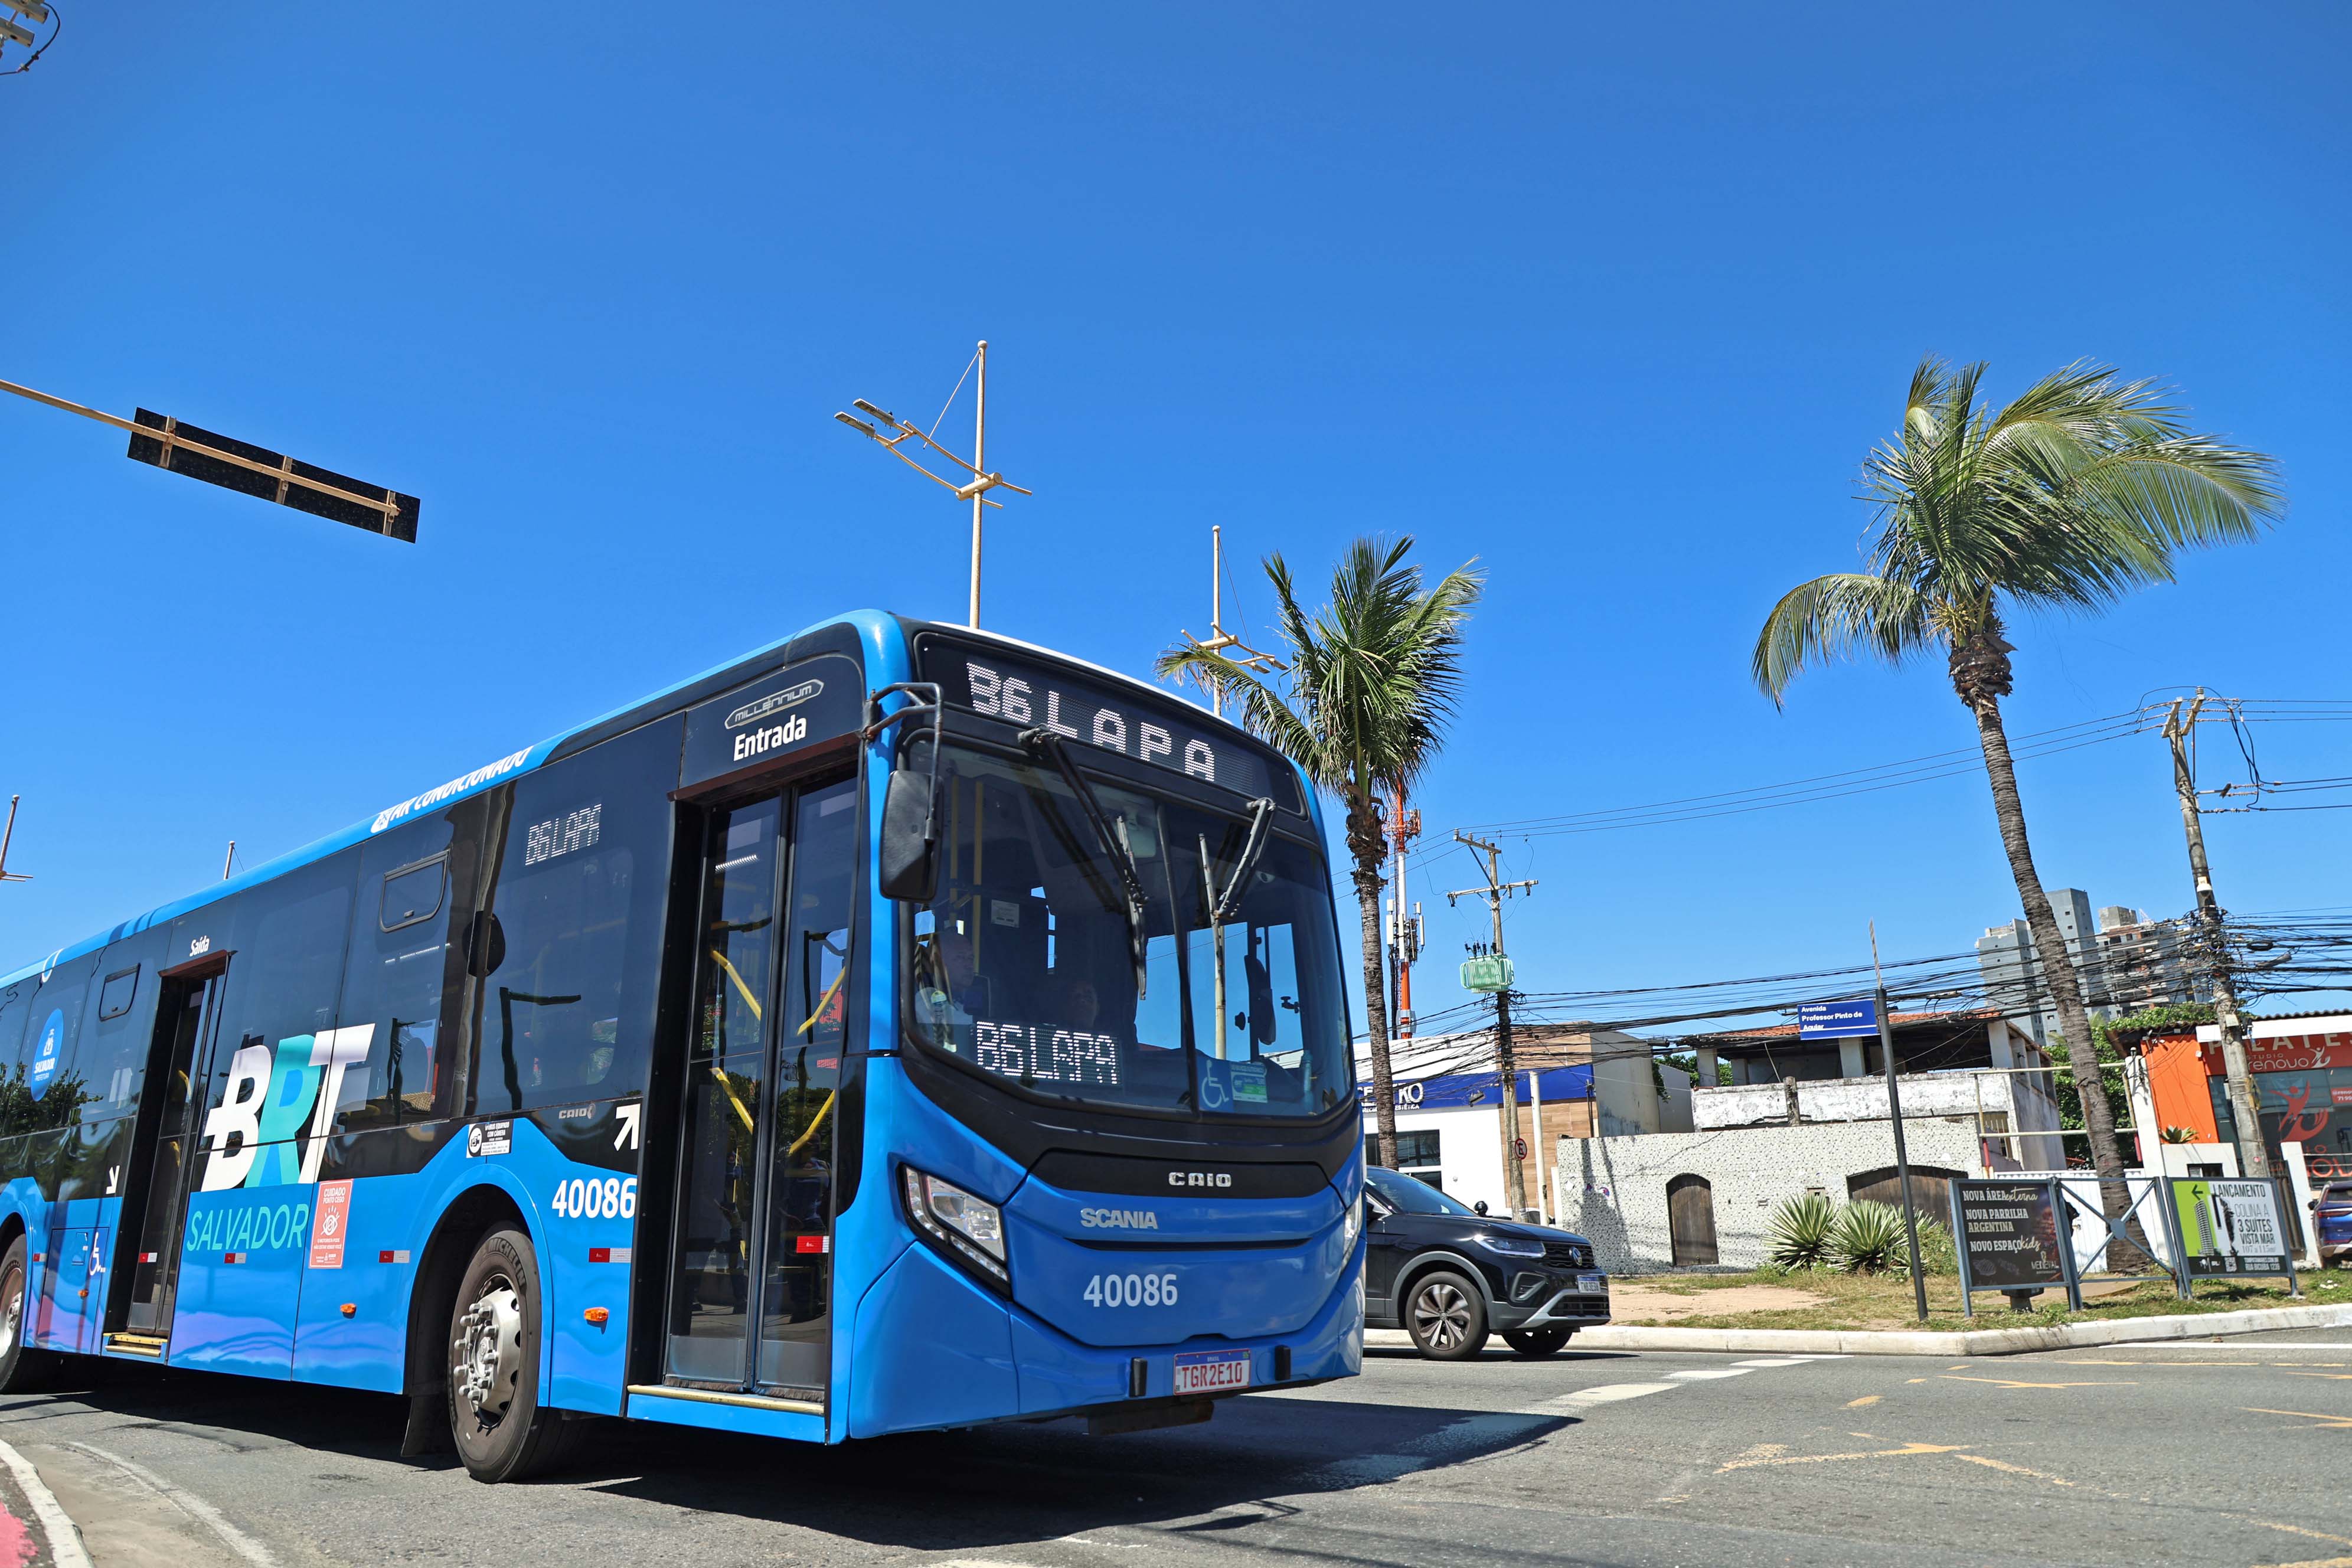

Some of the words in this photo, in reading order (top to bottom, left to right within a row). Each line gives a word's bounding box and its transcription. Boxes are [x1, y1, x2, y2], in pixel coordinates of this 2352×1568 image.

[734, 685, 812, 722] MILLENNIUM
[966, 662, 1032, 723] B6
[1047, 690, 1215, 782] LAPA
[733, 714, 807, 762] Entrada
[414, 745, 534, 811] CONDICIONADO
[525, 821, 552, 865] B6
[551, 803, 602, 857] LAPA
[189, 935, 210, 957] Saída
[976, 1021, 1024, 1077] B6
[1030, 1027, 1118, 1084] LAPA
[34, 1057, 56, 1074] SALVADOR
[200, 1023, 376, 1192] BRT
[558, 1108, 587, 1119] CAIO
[1168, 1172, 1231, 1187] CAIO
[324, 1187, 346, 1198] CUIDADO
[551, 1177, 638, 1219] 40086
[1962, 1190, 1985, 1201] NOVA
[1986, 1187, 2007, 1201] ÁREA
[2005, 1186, 2039, 1203] externa
[2214, 1184, 2266, 1198] LANÇAMENTO
[1080, 1208, 1159, 1229] SCANIA
[1965, 1209, 1988, 1220] NOVA
[1989, 1208, 2029, 1219] PARRILHA
[2234, 1203, 2262, 1217] COLINA
[186, 1204, 309, 1252] SALVADOR
[1968, 1221, 2014, 1233] ARGENTINA
[2237, 1219, 2244, 1233] 3
[1969, 1241, 1993, 1252] NOVO
[1993, 1240, 2022, 1254] ESPAÇO
[2239, 1233, 2259, 1244] VISTA
[2259, 1233, 2275, 1244] MAR
[487, 1237, 527, 1288] MICHELIN
[1083, 1274, 1178, 1307] 40086
[1182, 1362, 1242, 1389] TGR2E10
